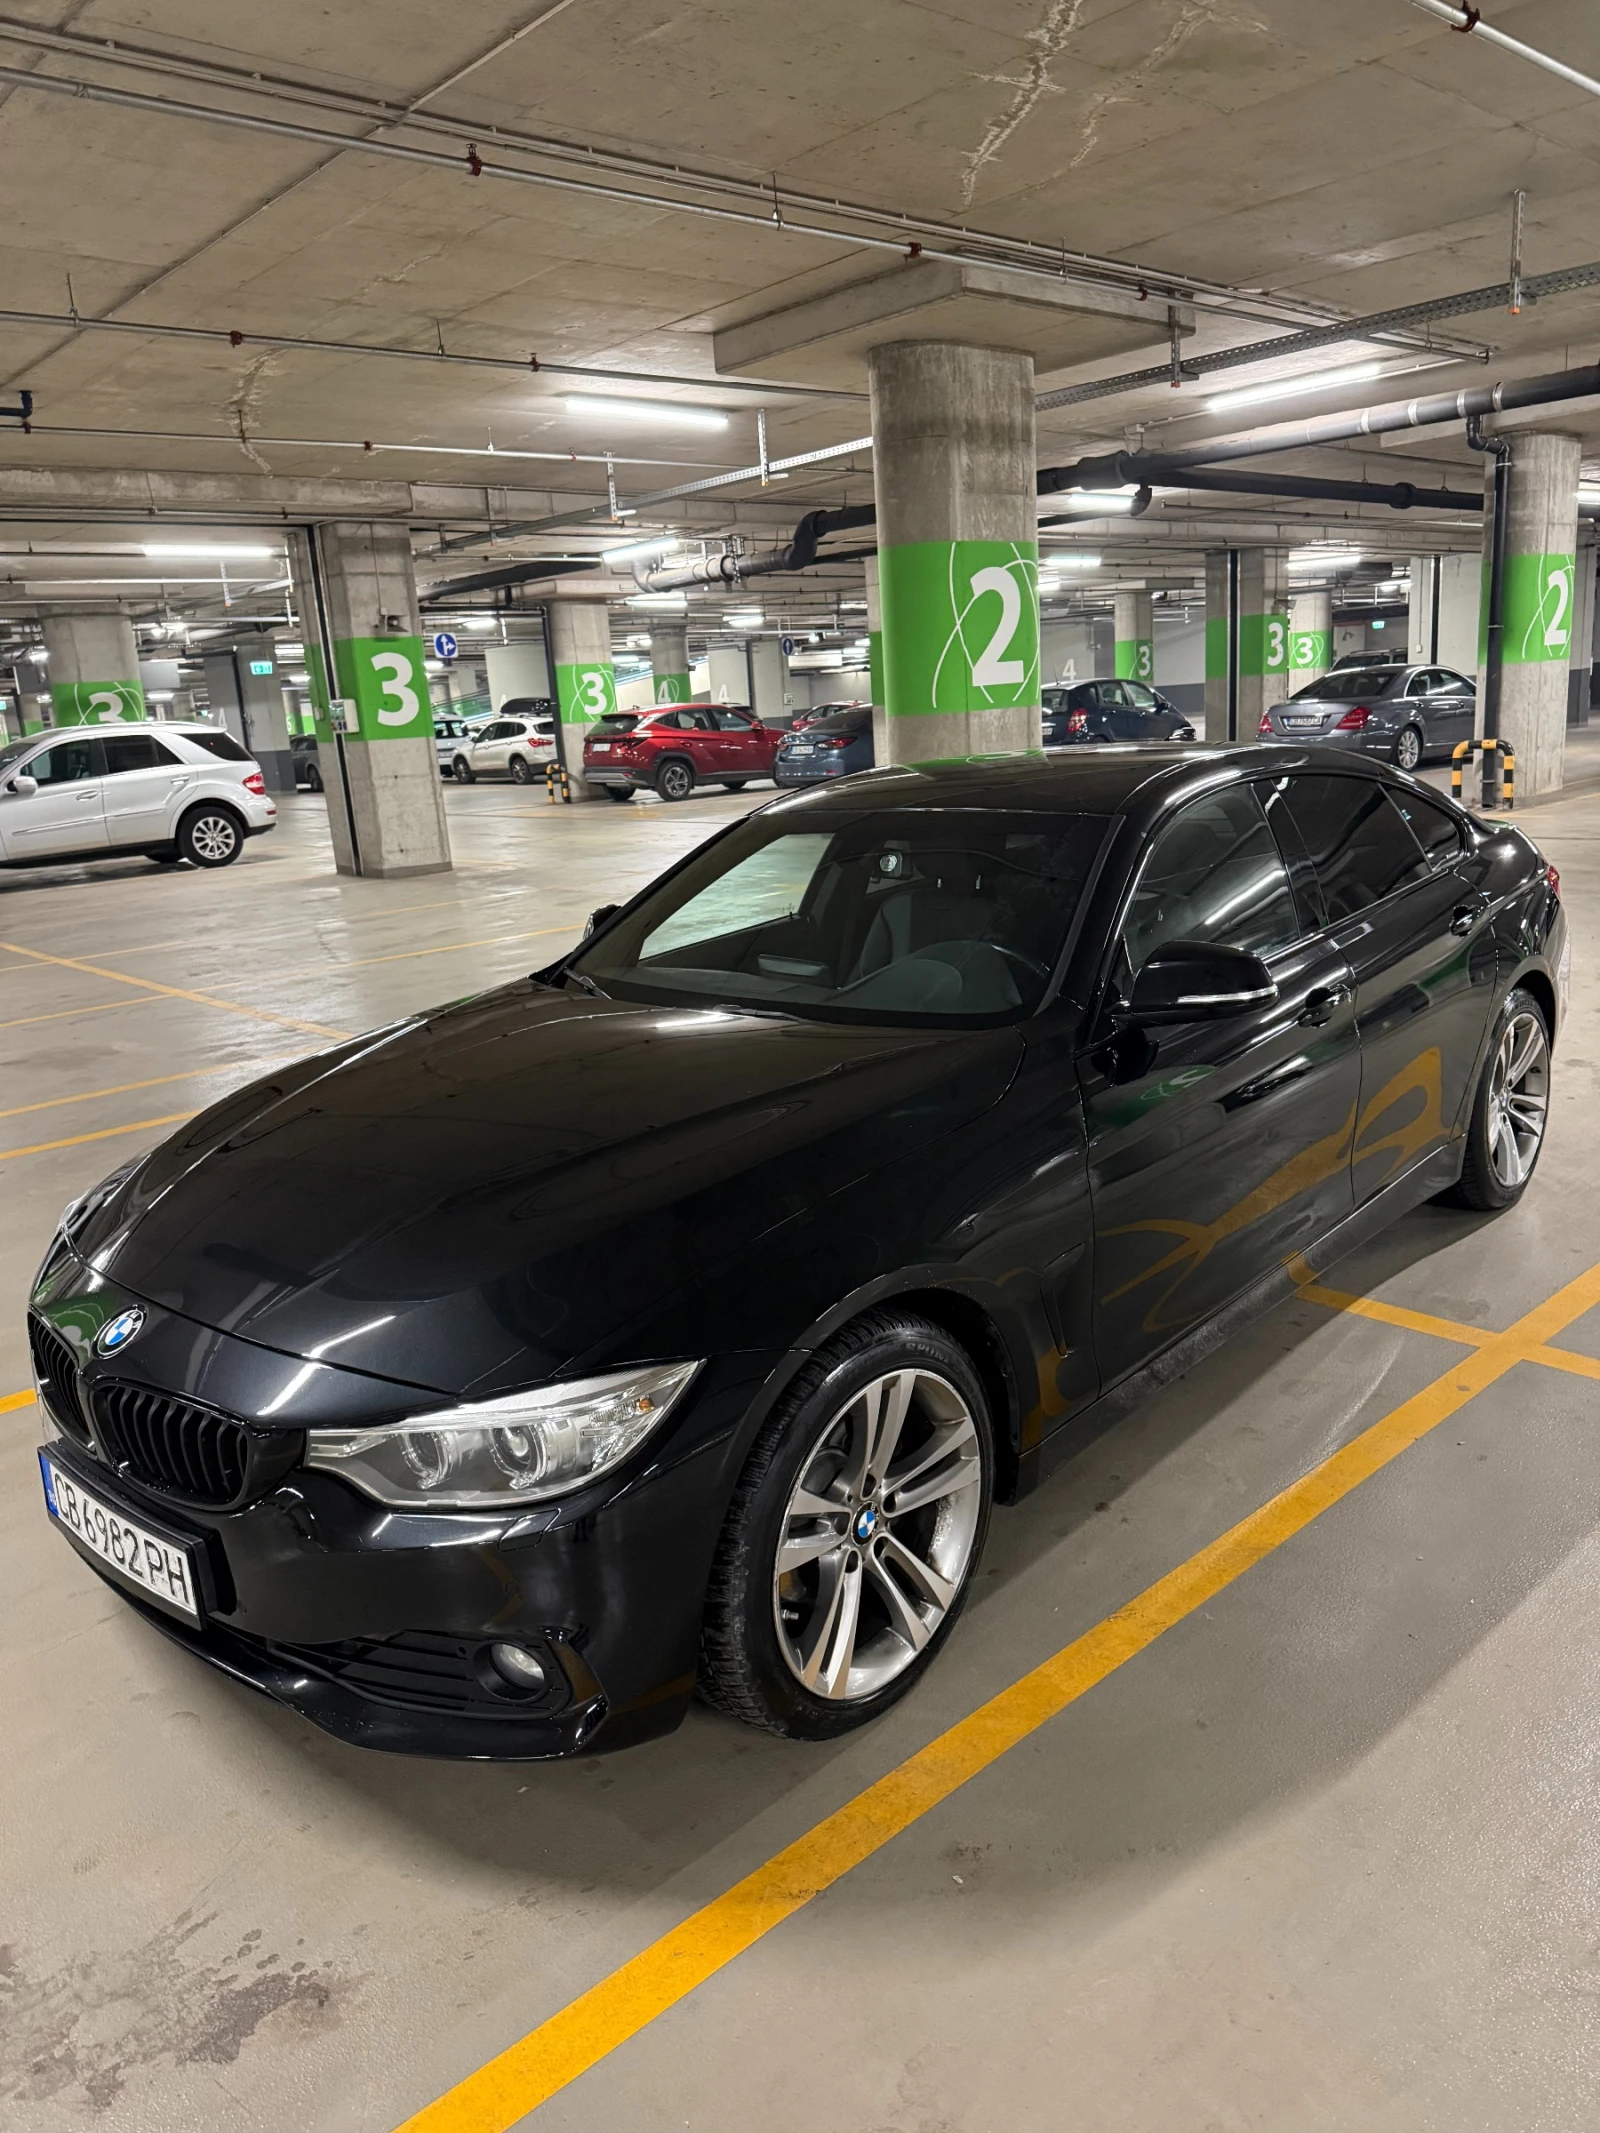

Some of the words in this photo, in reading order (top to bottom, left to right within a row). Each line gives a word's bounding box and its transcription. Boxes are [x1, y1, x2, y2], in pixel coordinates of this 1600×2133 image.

[970, 566, 1025, 687] 2
[1544, 570, 1568, 646] 2
[1138, 645, 1151, 676] 3
[1267, 622, 1284, 667] 3
[1296, 637, 1314, 665] 3
[1062, 658, 1077, 680] 4
[371, 652, 420, 727] 3
[581, 672, 608, 715] 3
[657, 680, 672, 704] 4
[718, 684, 730, 703] 4
